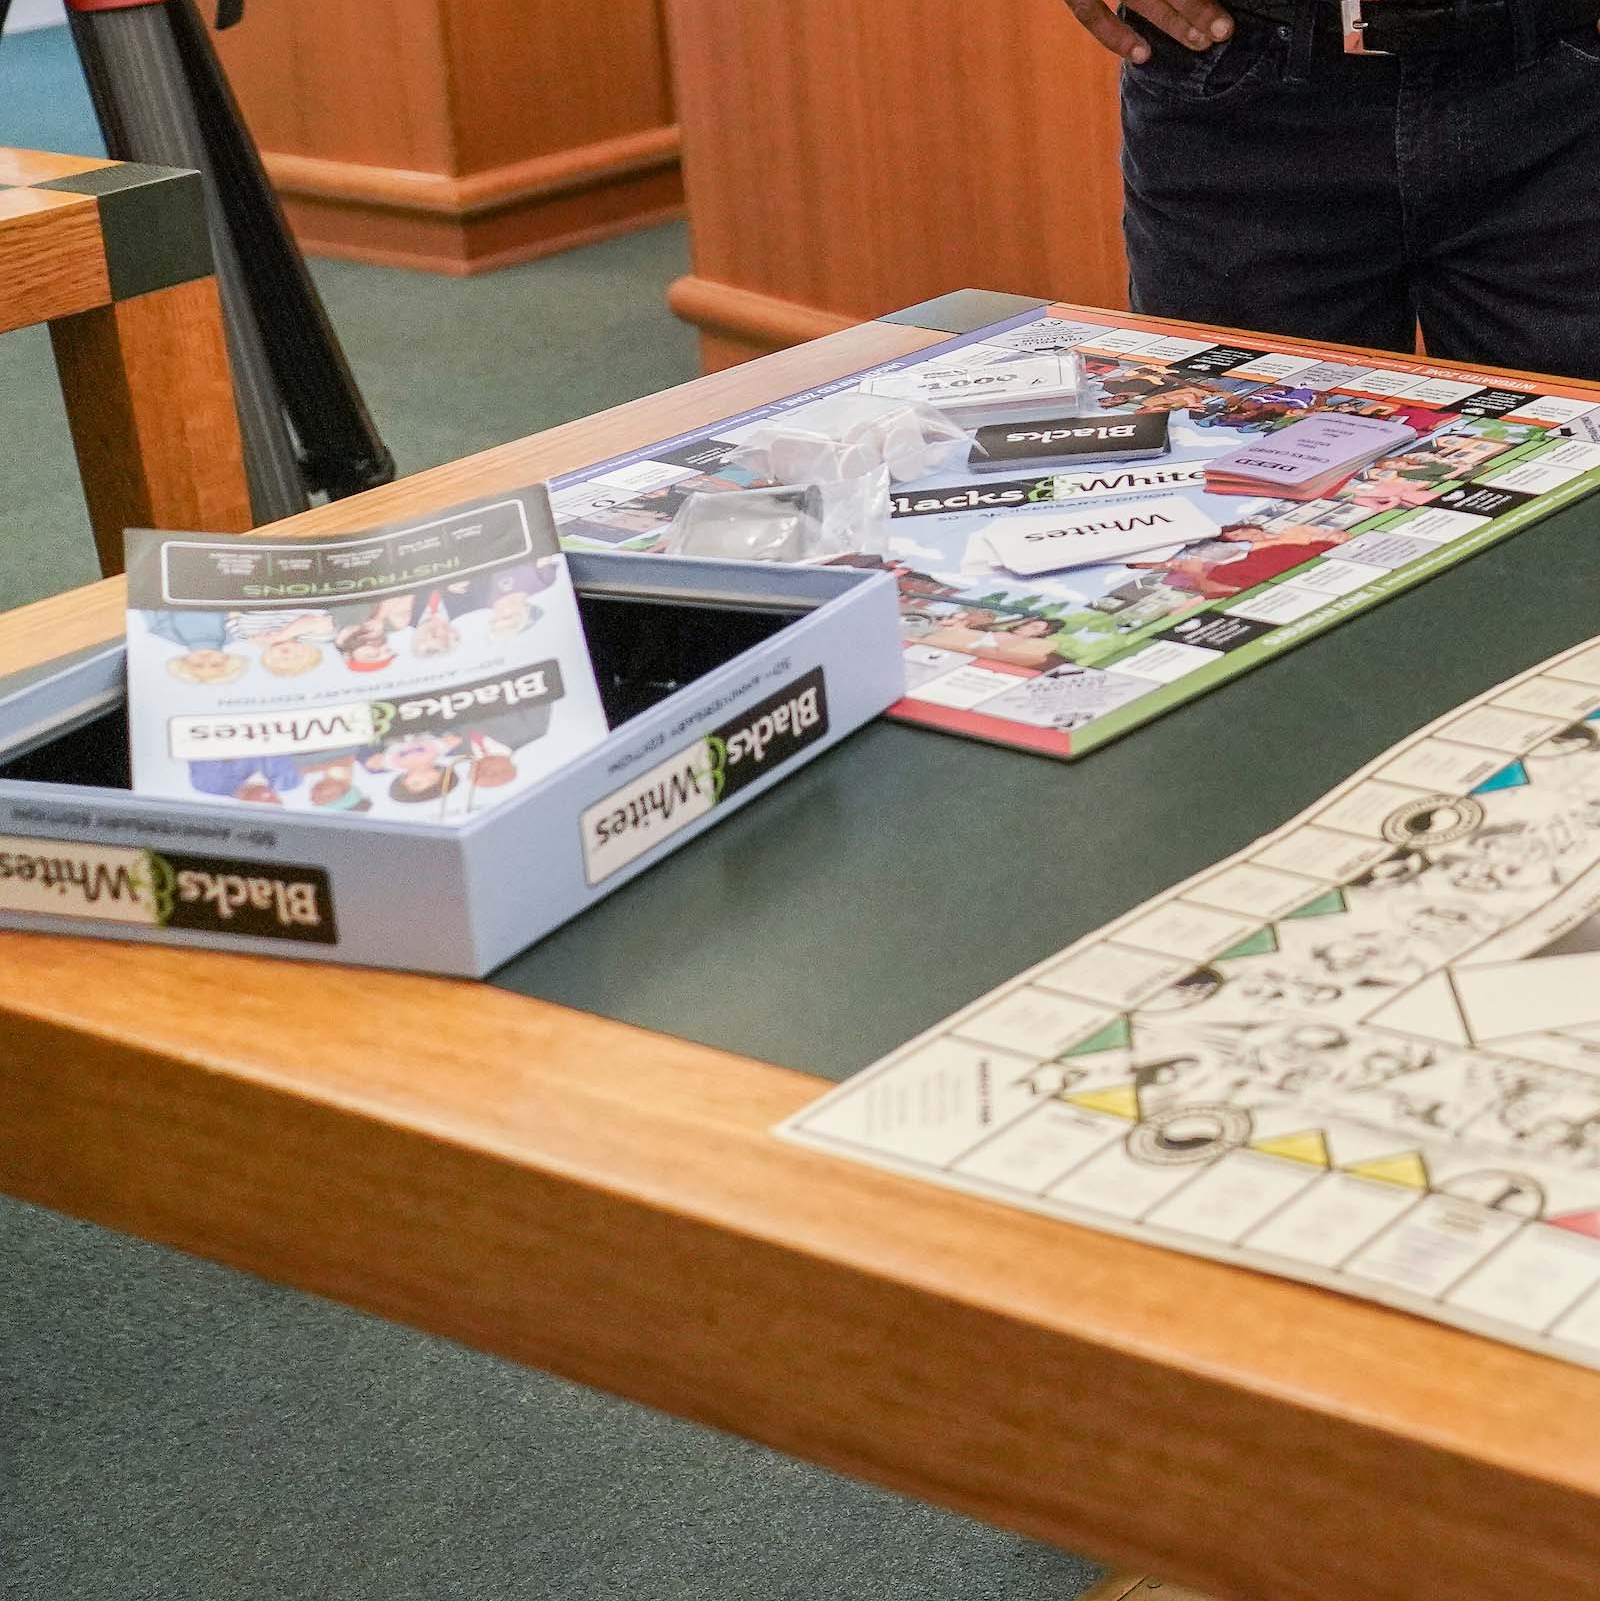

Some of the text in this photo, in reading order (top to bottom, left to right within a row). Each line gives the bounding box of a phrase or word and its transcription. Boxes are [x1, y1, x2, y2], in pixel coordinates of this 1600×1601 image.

[1456, 373, 1537, 391] INTEGRATED
[1005, 423, 1137, 444] Blacks
[1074, 469, 1205, 492] White
[1234, 457, 1298, 473] DEED
[1024, 513, 1176, 543] Whites
[243, 557, 462, 598] INSTRUCTIONS
[400, 670, 549, 721] Blacks
[189, 714, 351, 742] Whites
[726, 686, 820, 765] Blacks
[596, 765, 701, 846] Whites
[0, 852, 140, 905] Whites
[176, 869, 321, 927] Blacks
